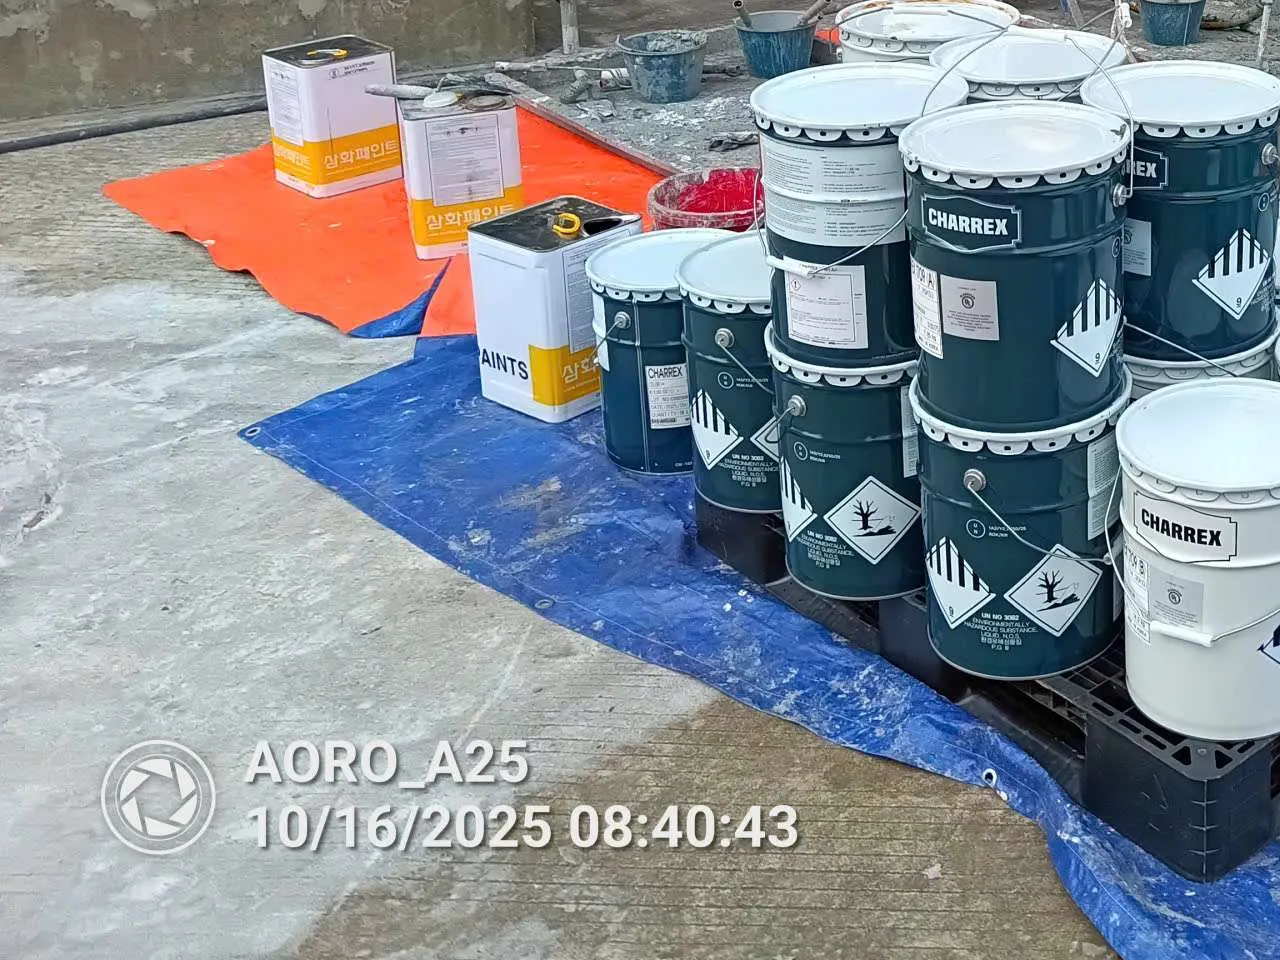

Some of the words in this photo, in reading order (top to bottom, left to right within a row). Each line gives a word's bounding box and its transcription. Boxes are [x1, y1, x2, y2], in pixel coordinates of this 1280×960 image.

[928, 208, 1008, 235] CHARREX
[648, 367, 682, 379] CHARREX
[1141, 508, 1222, 547] CHARREX
